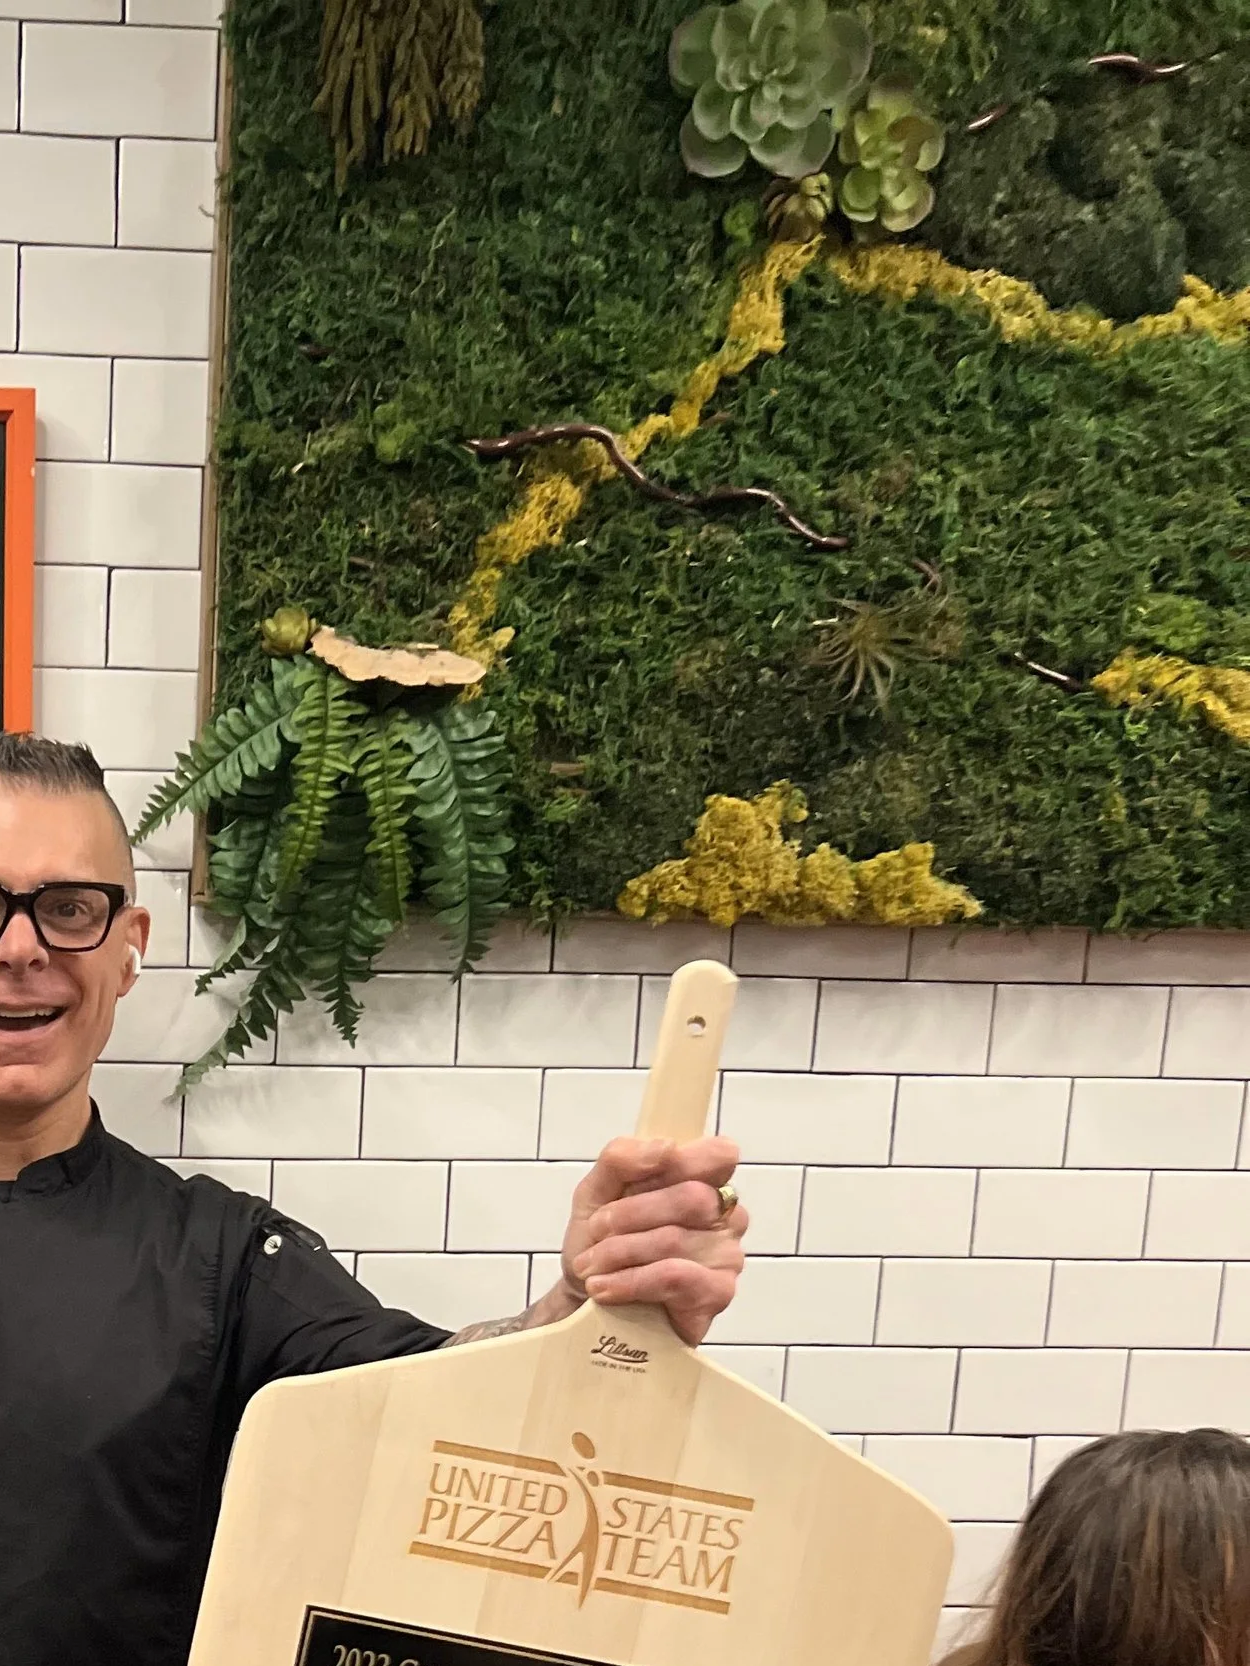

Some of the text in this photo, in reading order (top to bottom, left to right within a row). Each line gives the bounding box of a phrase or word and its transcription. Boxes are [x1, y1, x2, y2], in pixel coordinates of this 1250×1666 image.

[418, 1498, 736, 1594] PIZZA TEAM
[429, 1462, 744, 1550] UNITED STATES
